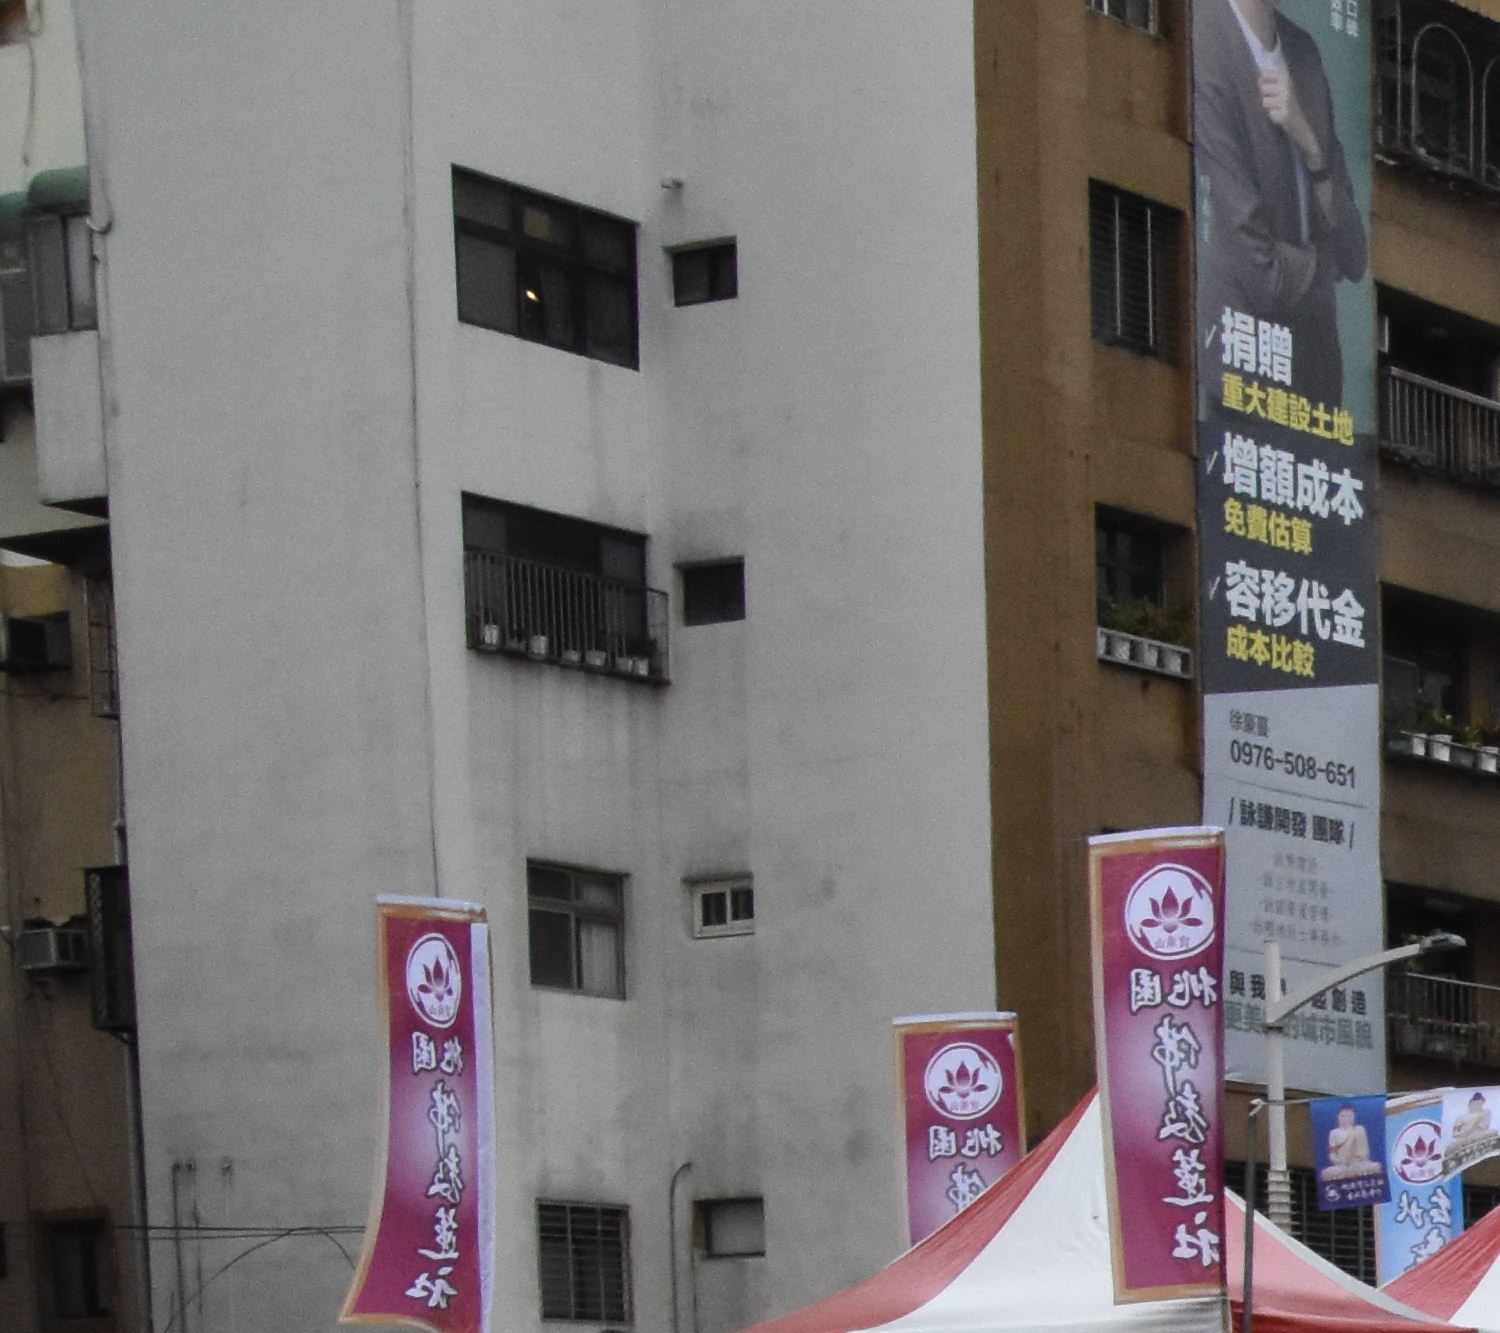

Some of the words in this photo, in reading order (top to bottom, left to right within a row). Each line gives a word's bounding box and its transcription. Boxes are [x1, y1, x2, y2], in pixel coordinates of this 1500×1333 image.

[1221, 306, 1293, 386] 捐贈
[1221, 372, 1355, 447] 重大建設土地
[1222, 431, 1364, 526] 增額成本
[1223, 497, 1314, 555] 免費估算
[1225, 560, 1367, 650] 容移代金
[1226, 625, 1316, 678] 成本比較
[1230, 738, 1356, 789] 0976-508-651
